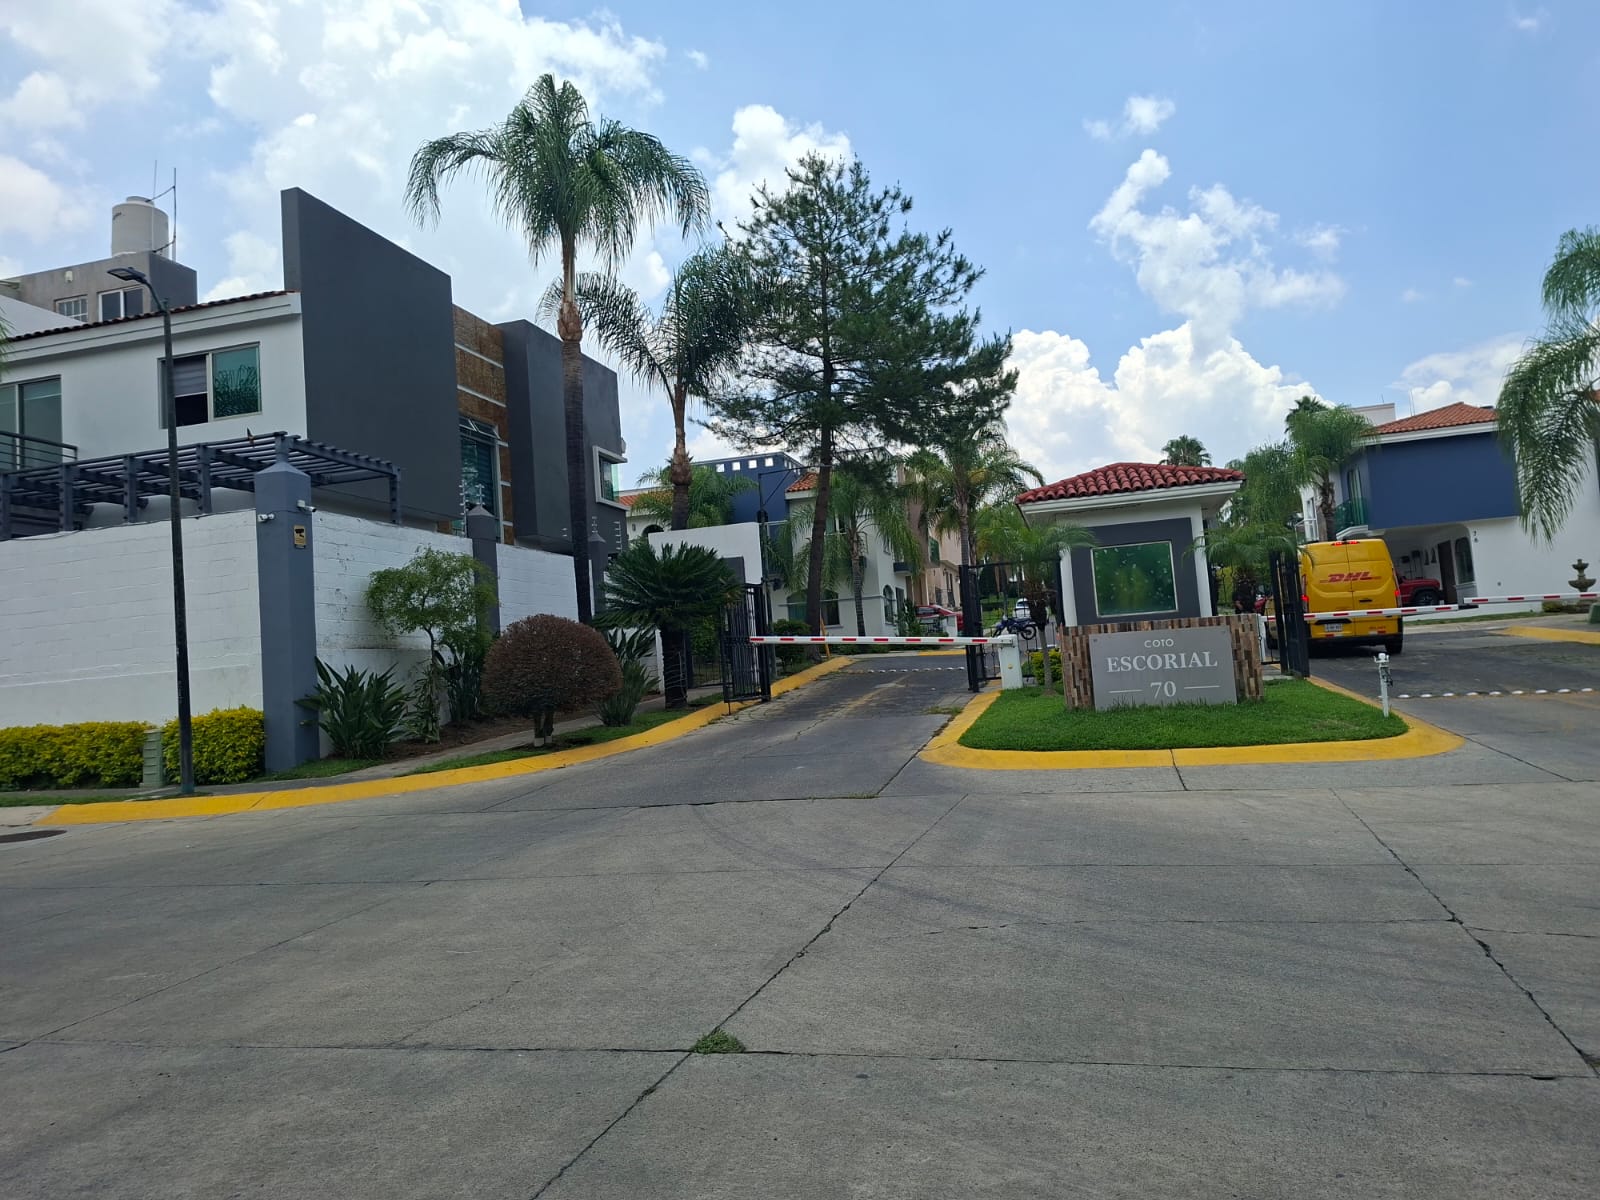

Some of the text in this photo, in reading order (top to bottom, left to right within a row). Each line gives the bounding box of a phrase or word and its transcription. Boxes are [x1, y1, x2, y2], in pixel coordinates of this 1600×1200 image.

[1328, 571, 1373, 582] DHL
[1143, 638, 1175, 649] COTO
[1106, 651, 1218, 673] ESCORIAL
[1150, 680, 1177, 699] 70
